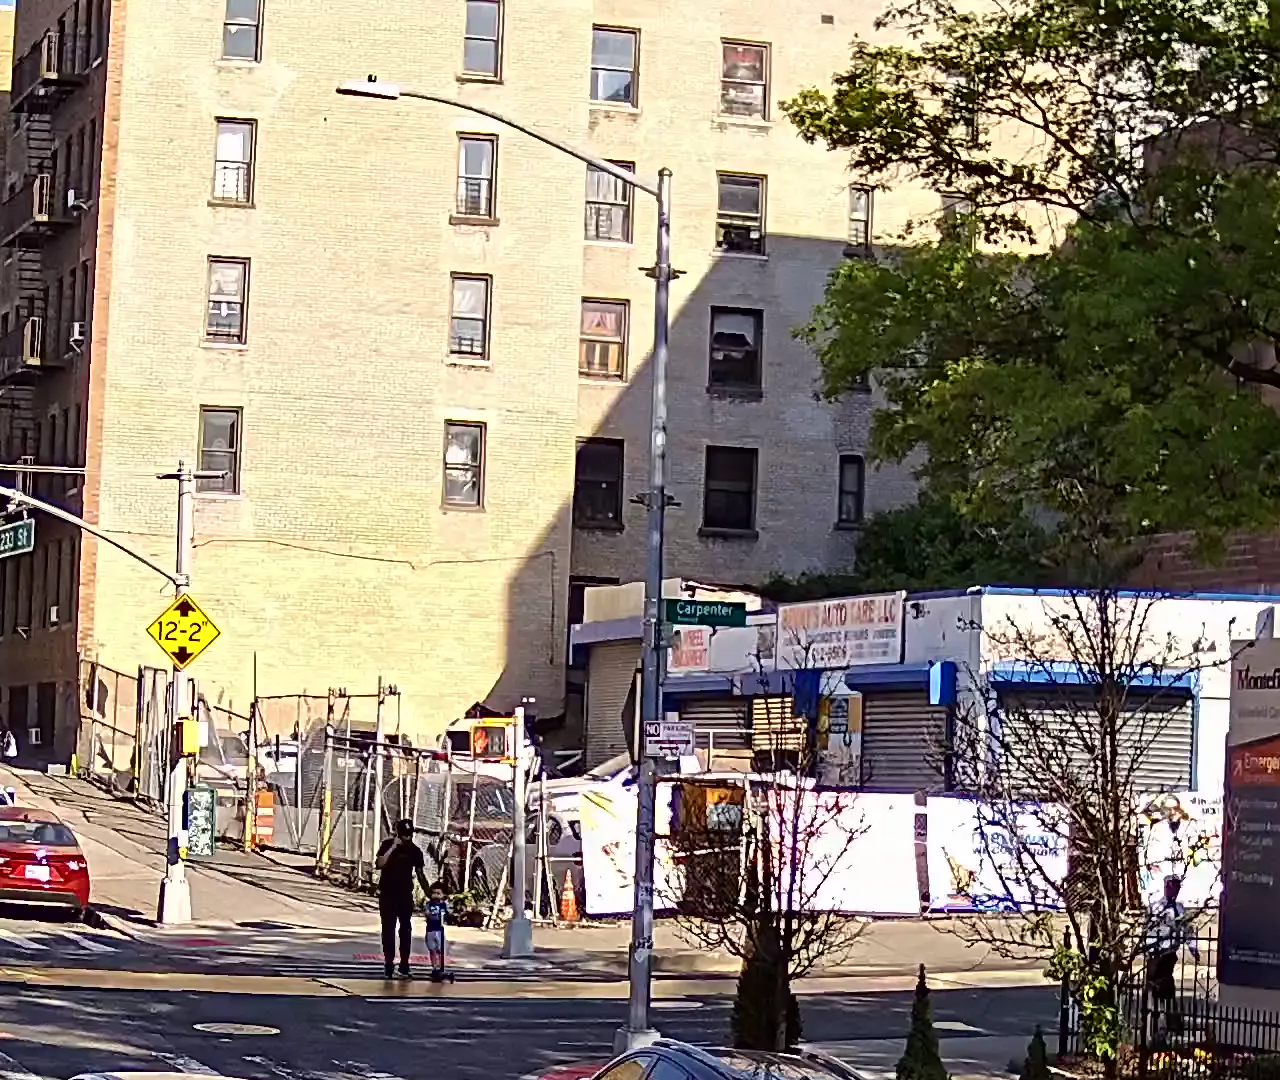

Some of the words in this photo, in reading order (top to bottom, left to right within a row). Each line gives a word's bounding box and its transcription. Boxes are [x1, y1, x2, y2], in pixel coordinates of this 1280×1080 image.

[17, 528, 28, 546] St
[676, 601, 734, 617] Carpenter
[646, 723, 660, 736] NO
